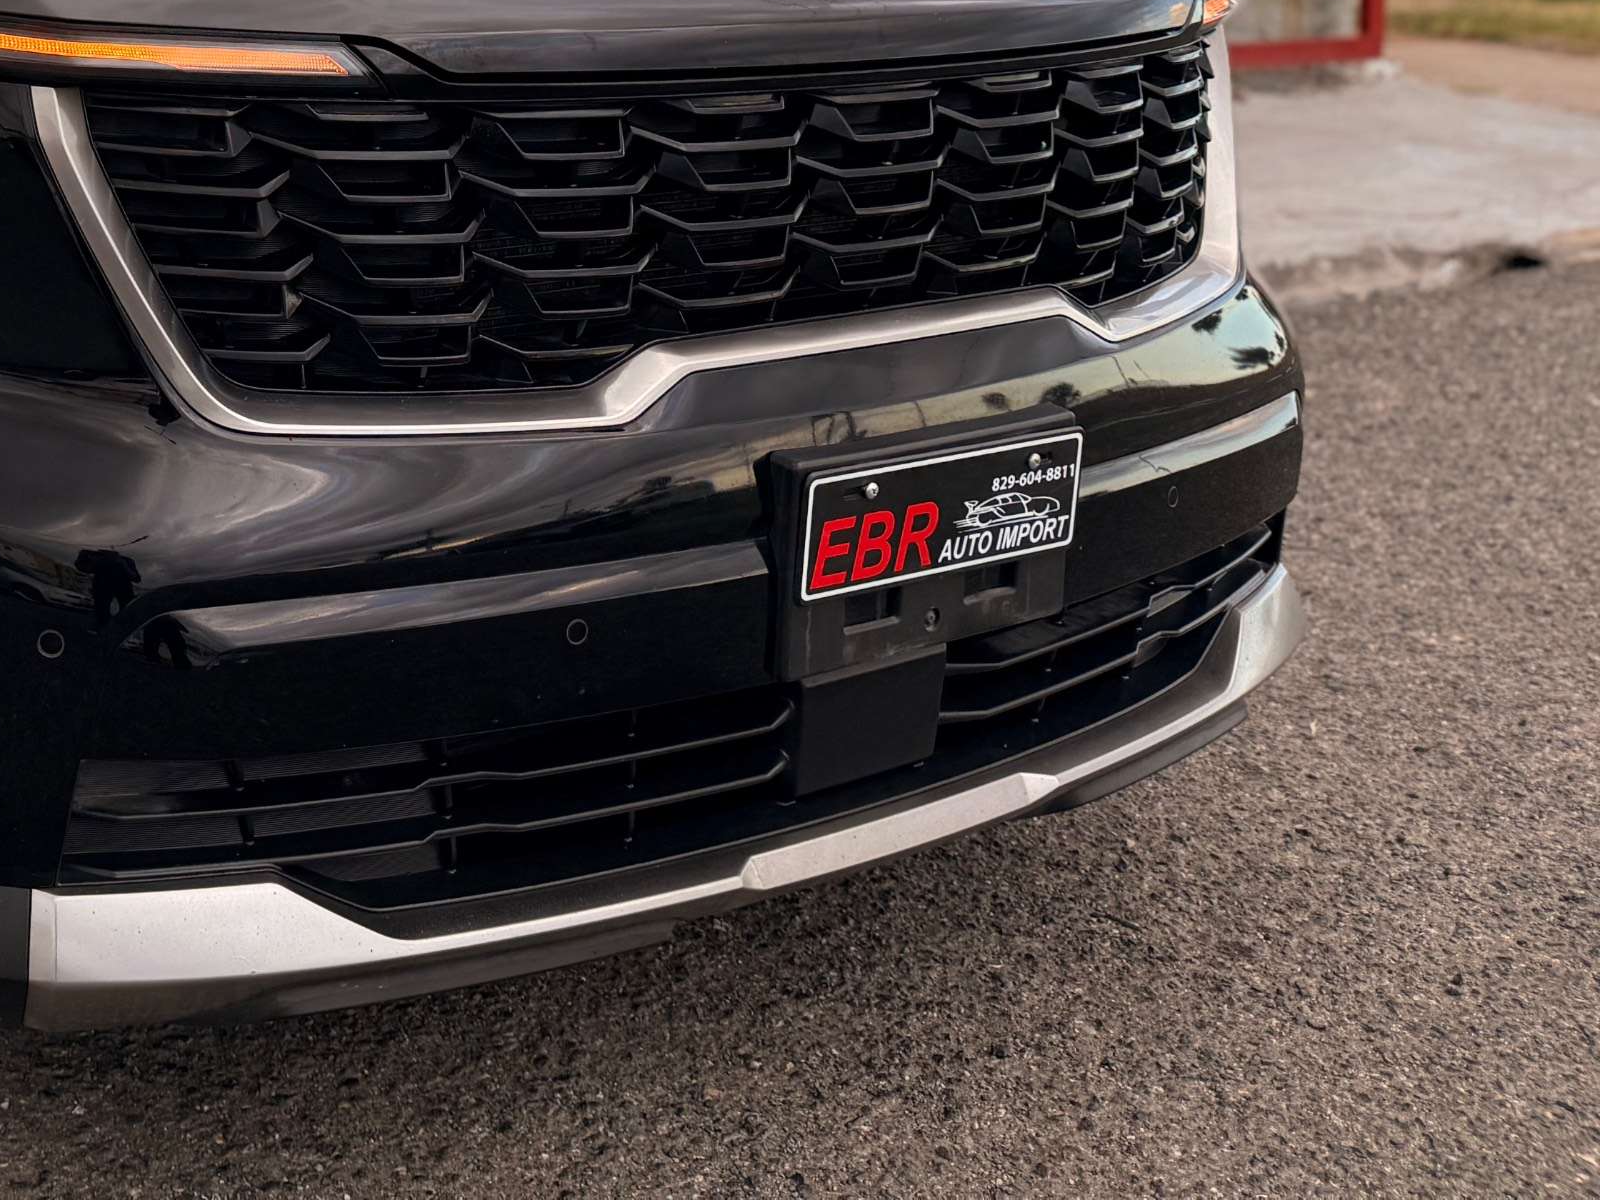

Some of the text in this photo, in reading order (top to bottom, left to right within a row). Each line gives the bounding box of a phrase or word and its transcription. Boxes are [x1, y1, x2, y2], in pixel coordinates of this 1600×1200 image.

[992, 463, 1075, 492] 829-604-8811
[809, 501, 939, 589] EBR
[938, 514, 1069, 563] AUTO IMPORT
